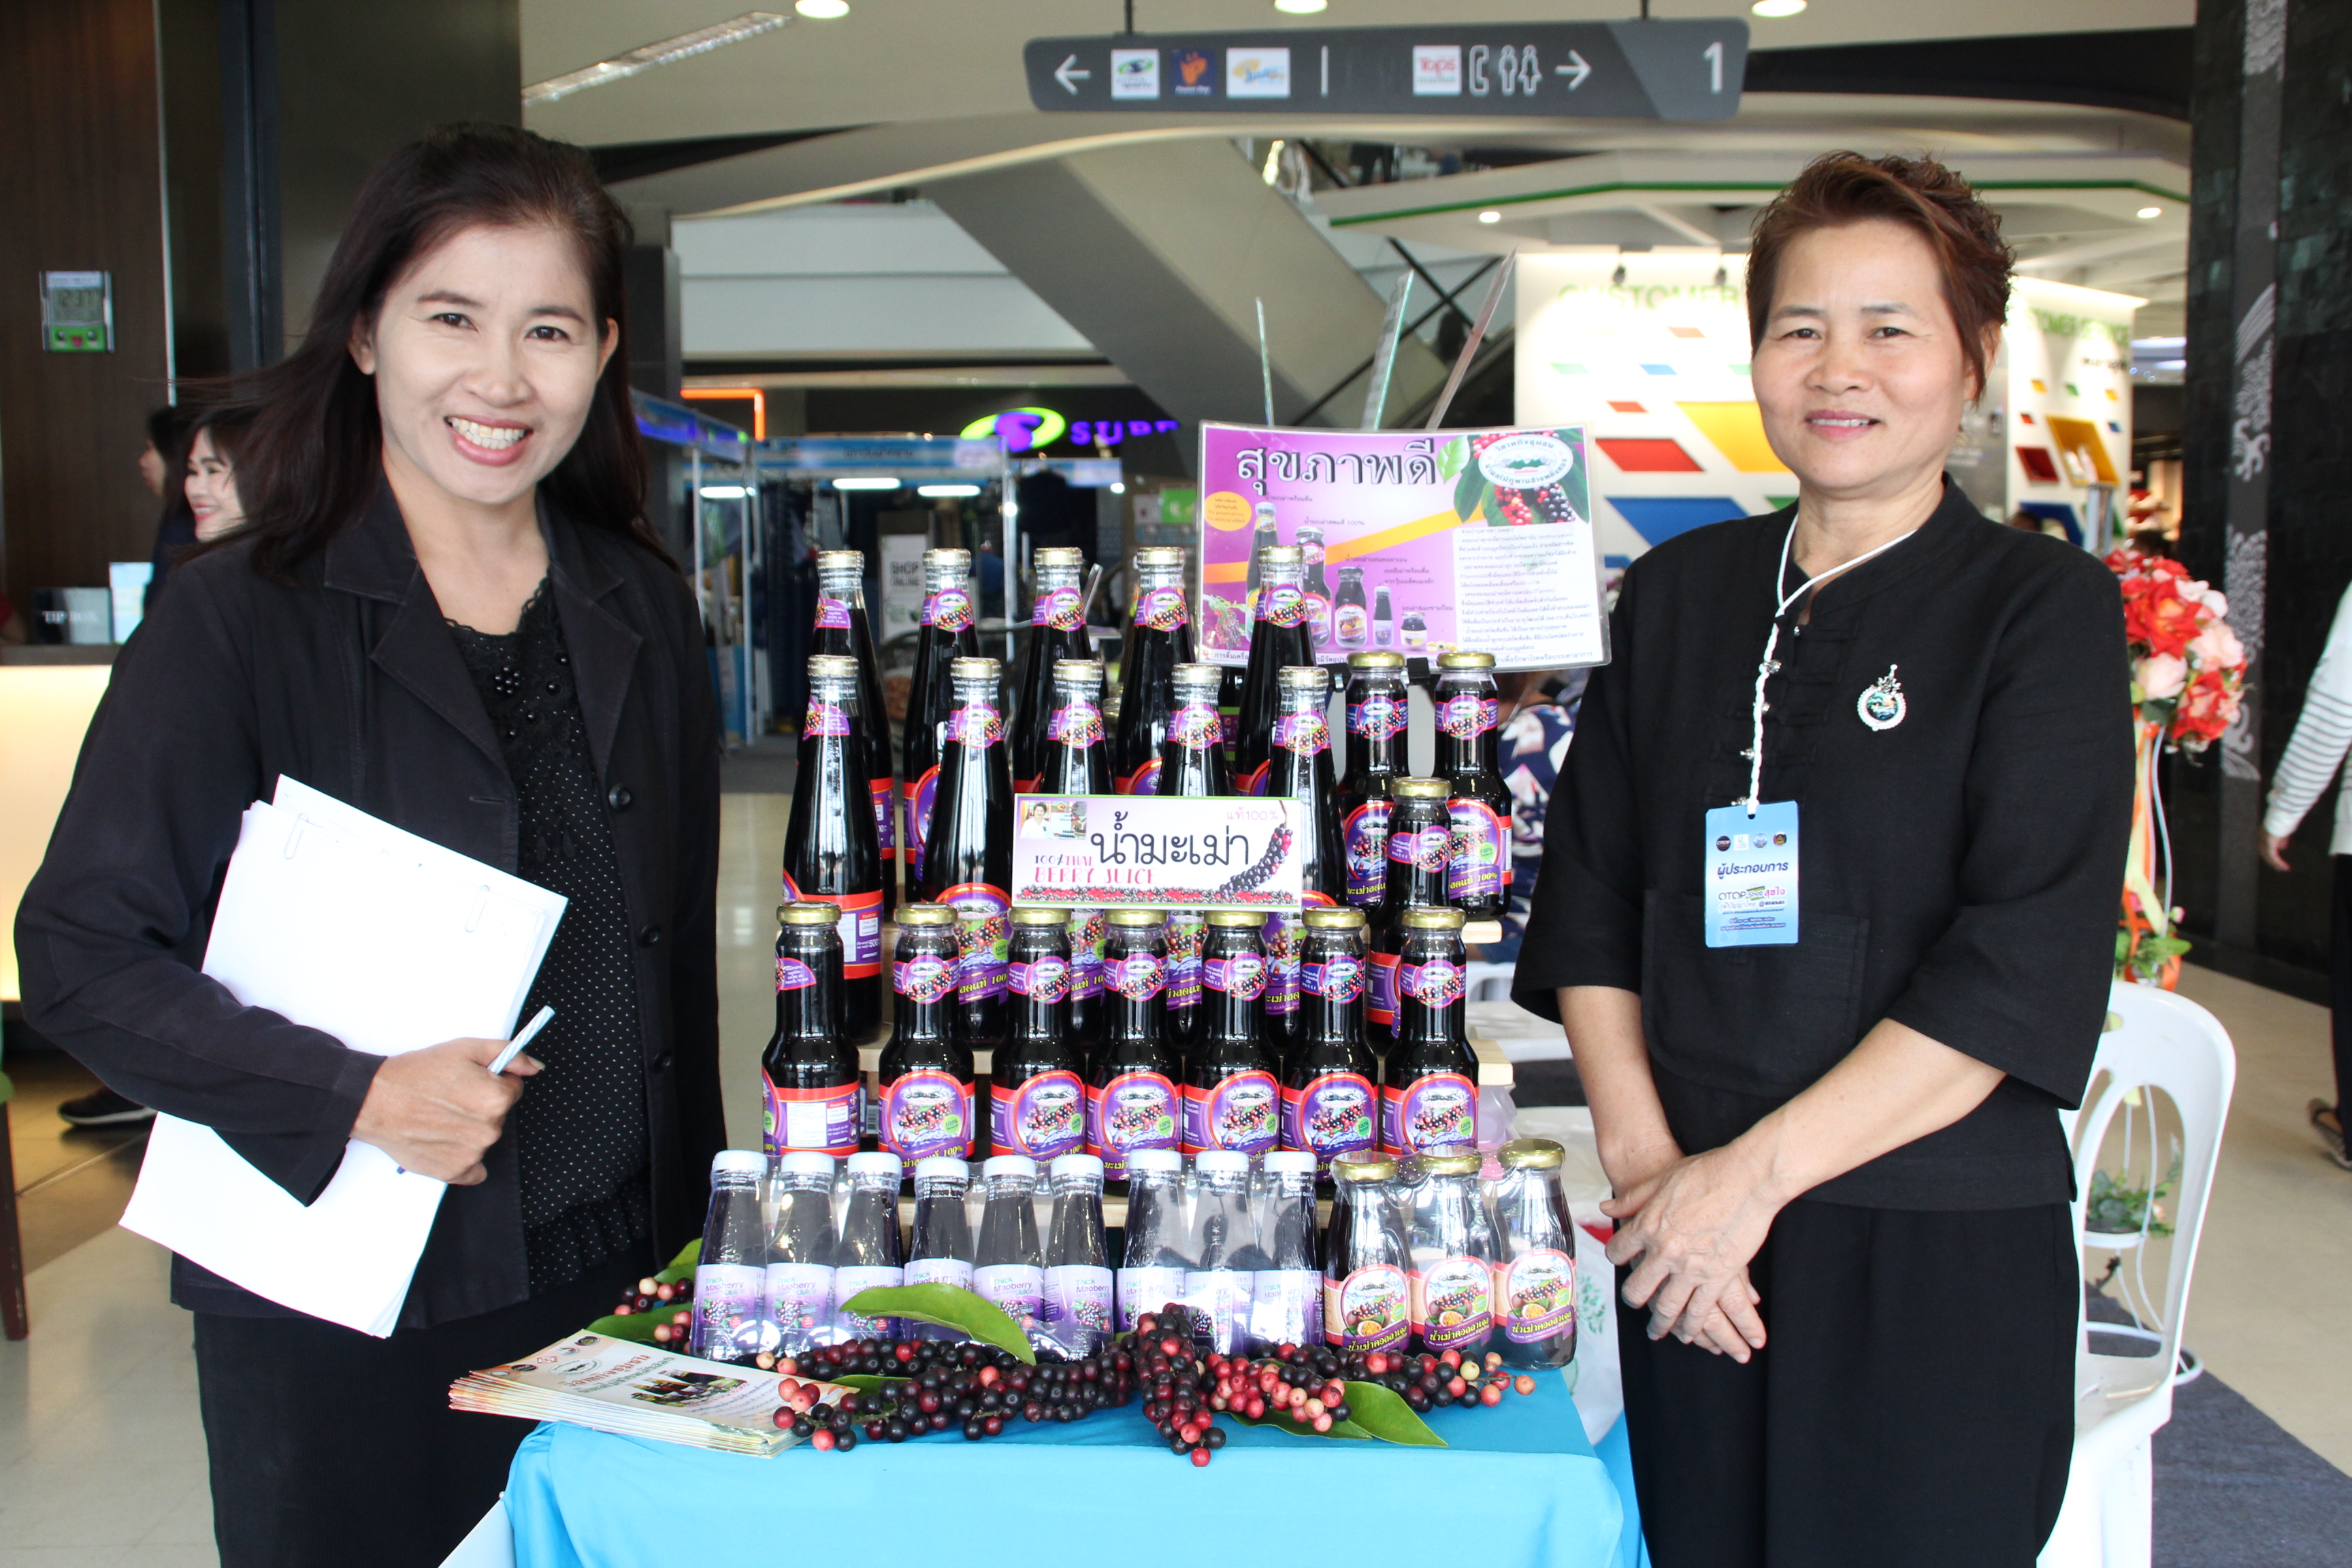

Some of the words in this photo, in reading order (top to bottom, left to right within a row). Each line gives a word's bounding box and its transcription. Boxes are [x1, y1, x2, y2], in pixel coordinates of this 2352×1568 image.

[1418, 56, 1456, 75] Tops
[1703, 42, 1722, 93] 1
[1559, 284, 1740, 308] CSTOMER
[1236, 436, 1436, 496] สุขภาพดี
[1090, 811, 1249, 866] น้ำมะเม่า
[1034, 866, 1094, 883] BERRY
[1103, 868, 1158, 884] JUICE
[1477, 870, 1498, 882] 100%
[1717, 862, 1789, 879] ผู้ประกอบการ
[1718, 892, 1747, 901] OTOP
[991, 973, 1007, 985] 100
[945, 1119, 958, 1127] 100%
[1158, 1120, 1171, 1128] 100%
[943, 1145, 963, 1156] 100%
[705, 1281, 745, 1292] Maoberry
[706, 1277, 723, 1285] Thick
[777, 1281, 816, 1291] Maoberry
[993, 1277, 1013, 1285] Thick
[994, 1281, 1033, 1293] Maoberry
[1126, 1279, 1142, 1288] Thic
[797, 1288, 817, 1296] Juice
[1076, 1284, 1110, 1294] Maoberry
[1126, 1284, 1164, 1296] Maoerry
[1263, 1284, 1281, 1292] Thick
[1512, 1310, 1572, 1334] น้ำเม่าคอลลาเจน
[1429, 1317, 1490, 1342] น้ำเม่าคอลลาเจน
